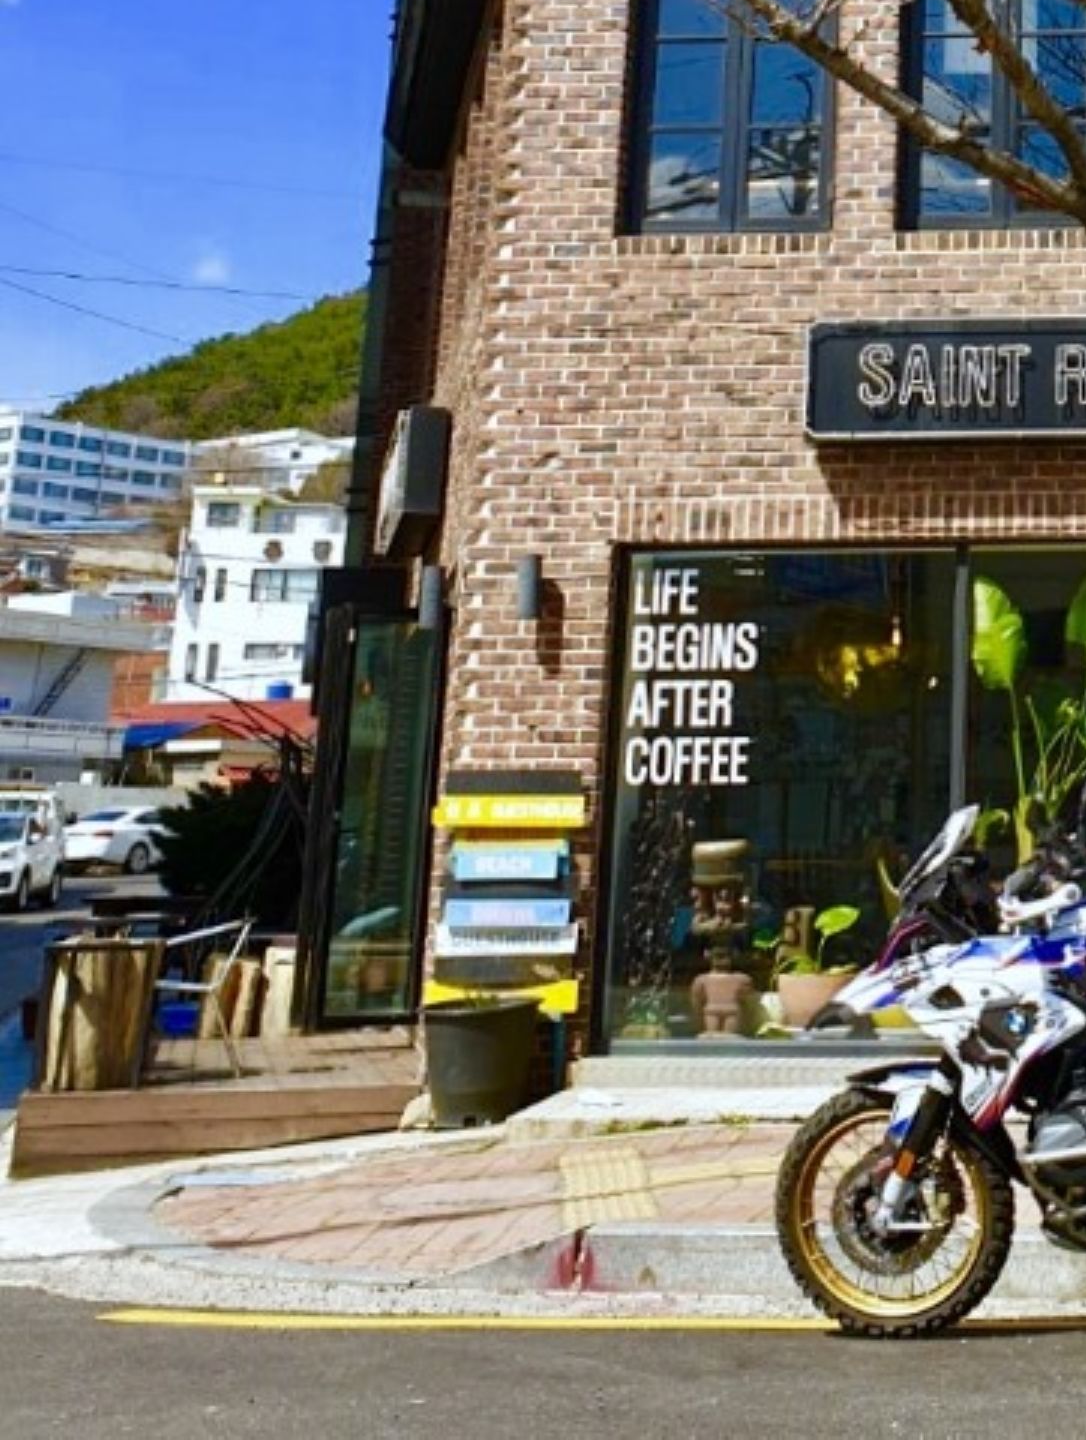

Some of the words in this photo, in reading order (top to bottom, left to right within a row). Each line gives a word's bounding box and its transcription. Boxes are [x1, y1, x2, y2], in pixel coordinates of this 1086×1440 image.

[858, 343, 1032, 408] SAINT
[634, 568, 699, 616] LIFE
[631, 622, 759, 672] BEGINS
[626, 679, 734, 728] AFTER
[625, 736, 751, 787] COFFEE
